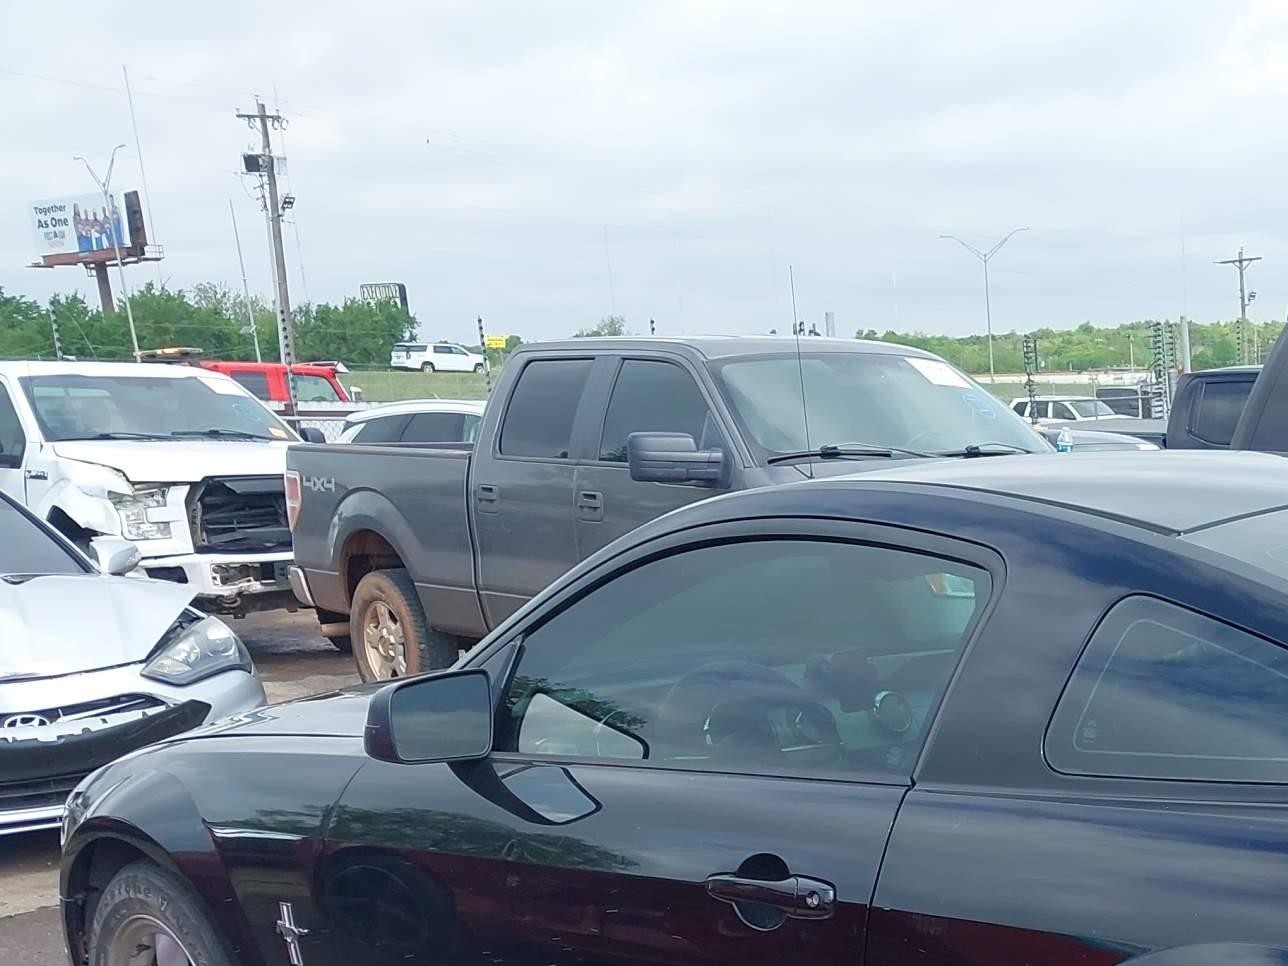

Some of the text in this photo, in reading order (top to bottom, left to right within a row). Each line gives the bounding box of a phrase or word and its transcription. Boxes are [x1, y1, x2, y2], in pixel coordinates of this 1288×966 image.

[33, 204, 66, 216] Together
[38, 217, 69, 229] As One
